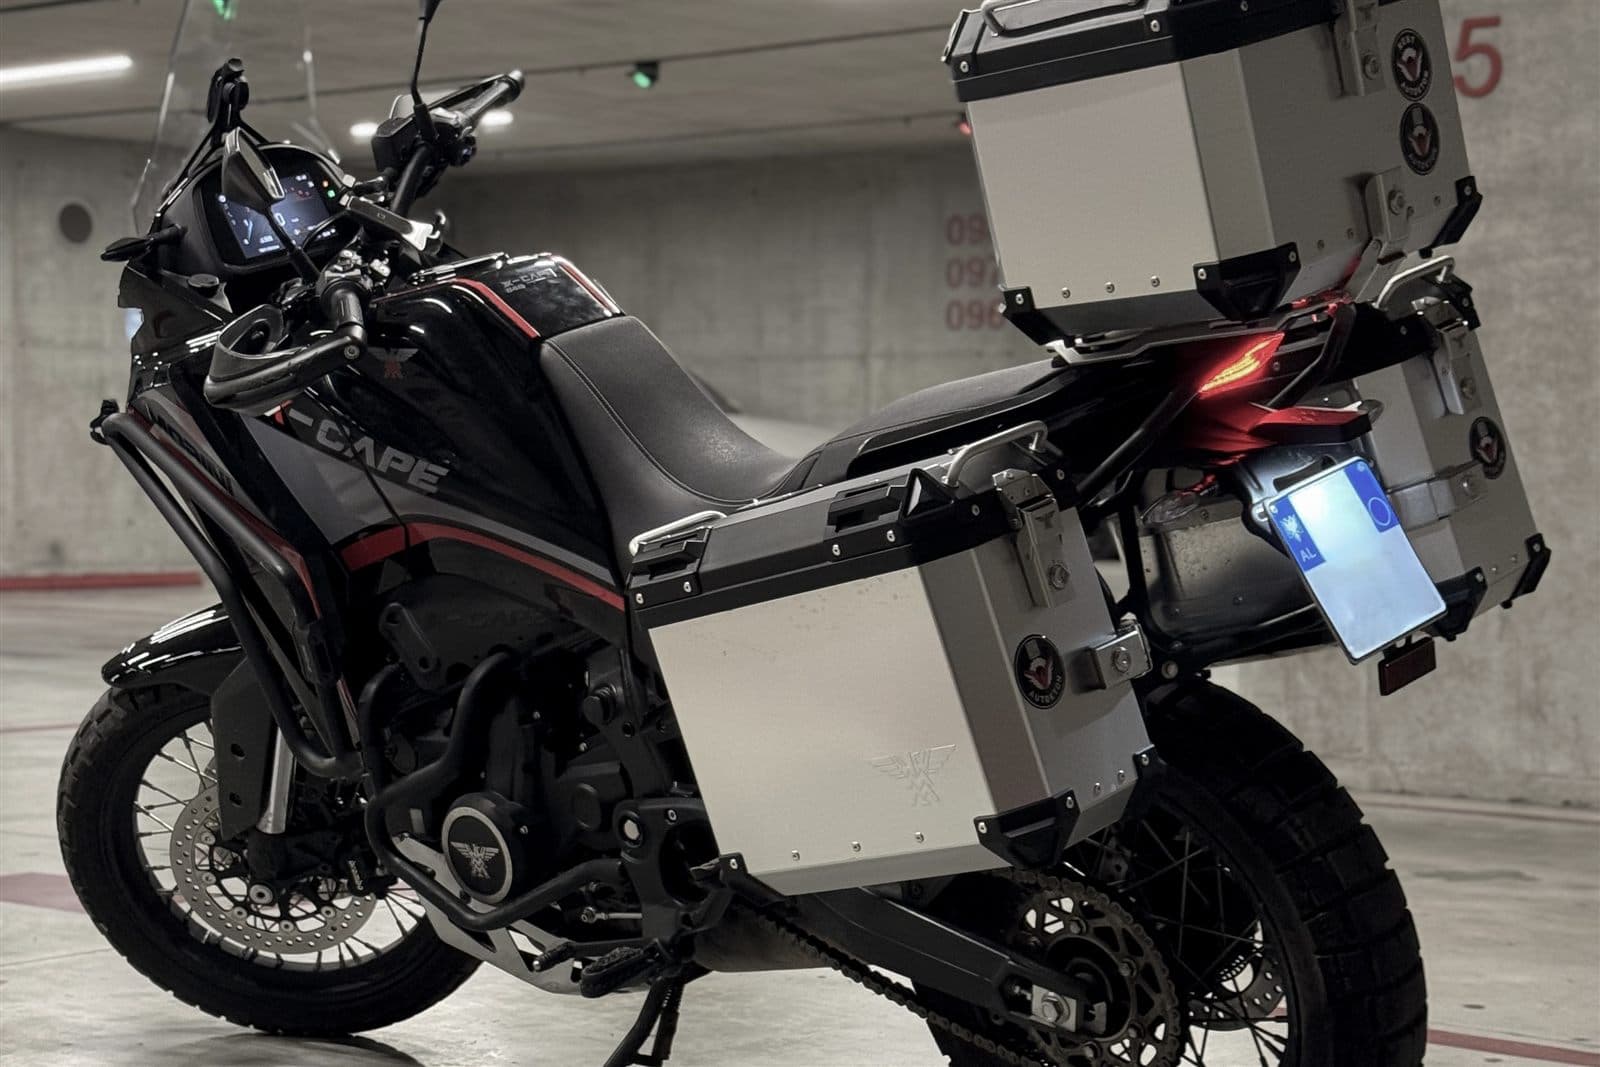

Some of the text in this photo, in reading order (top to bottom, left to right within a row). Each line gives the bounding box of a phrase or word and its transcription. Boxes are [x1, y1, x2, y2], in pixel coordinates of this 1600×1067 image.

[1454, 14, 1504, 98] 5
[945, 213, 988, 246] 09
[274, 400, 450, 494] -CAPE
[1300, 548, 1317, 563] AL
